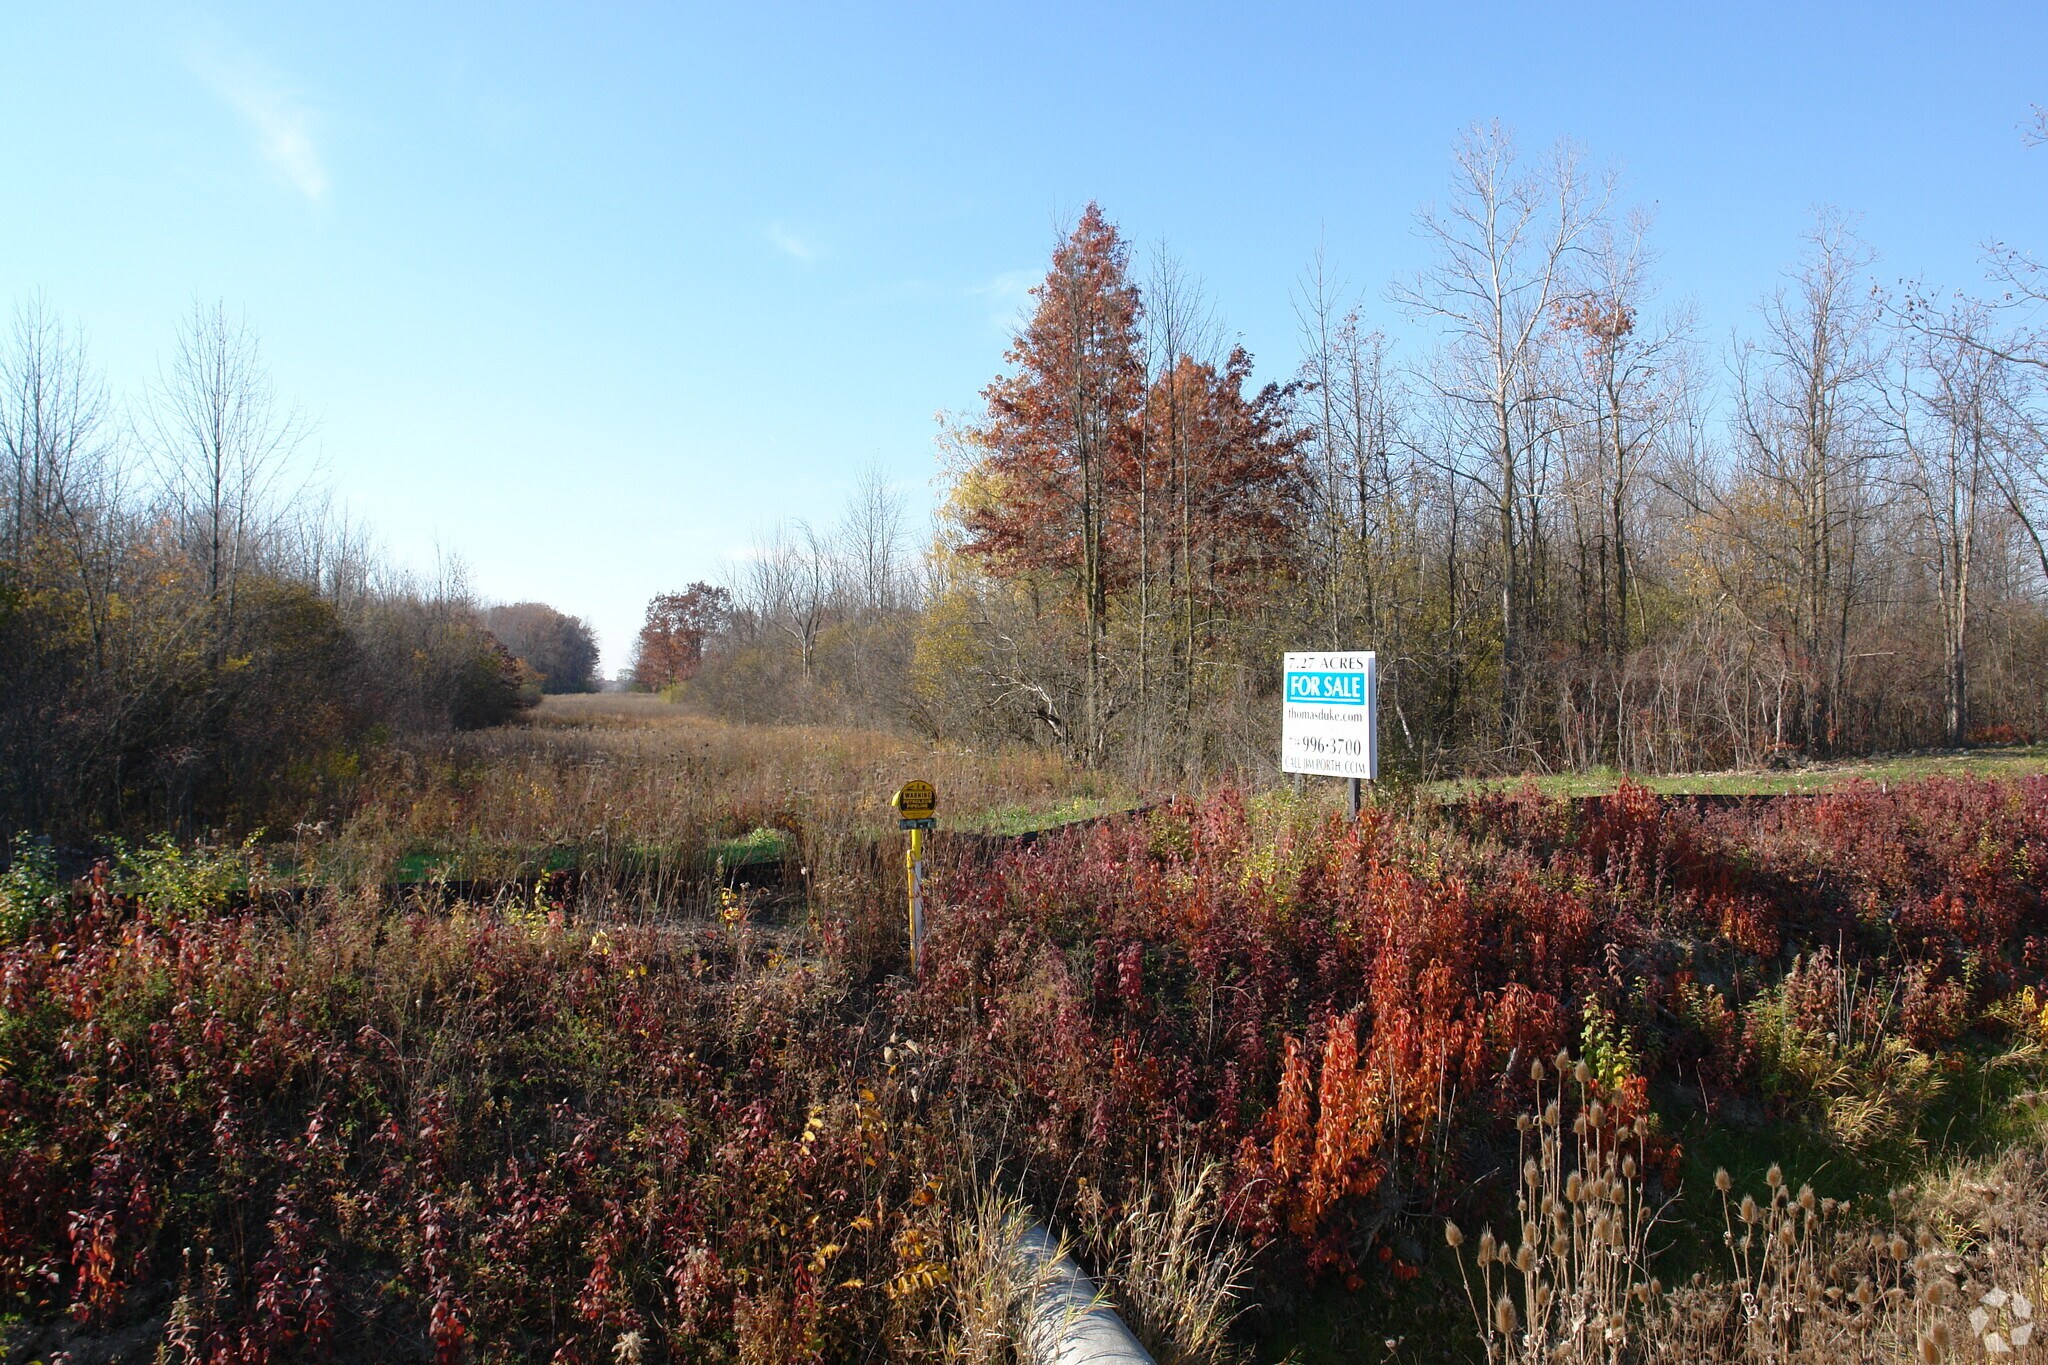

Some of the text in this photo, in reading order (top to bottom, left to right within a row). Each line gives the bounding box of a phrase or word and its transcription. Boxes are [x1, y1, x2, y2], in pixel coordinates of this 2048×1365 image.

[1289, 656, 1364, 669] 7.27 ACRES
[1291, 676, 1361, 697] FOR SALE
[1289, 707, 1362, 722] thomasduke.com
[1285, 756, 1301, 769] CALL
